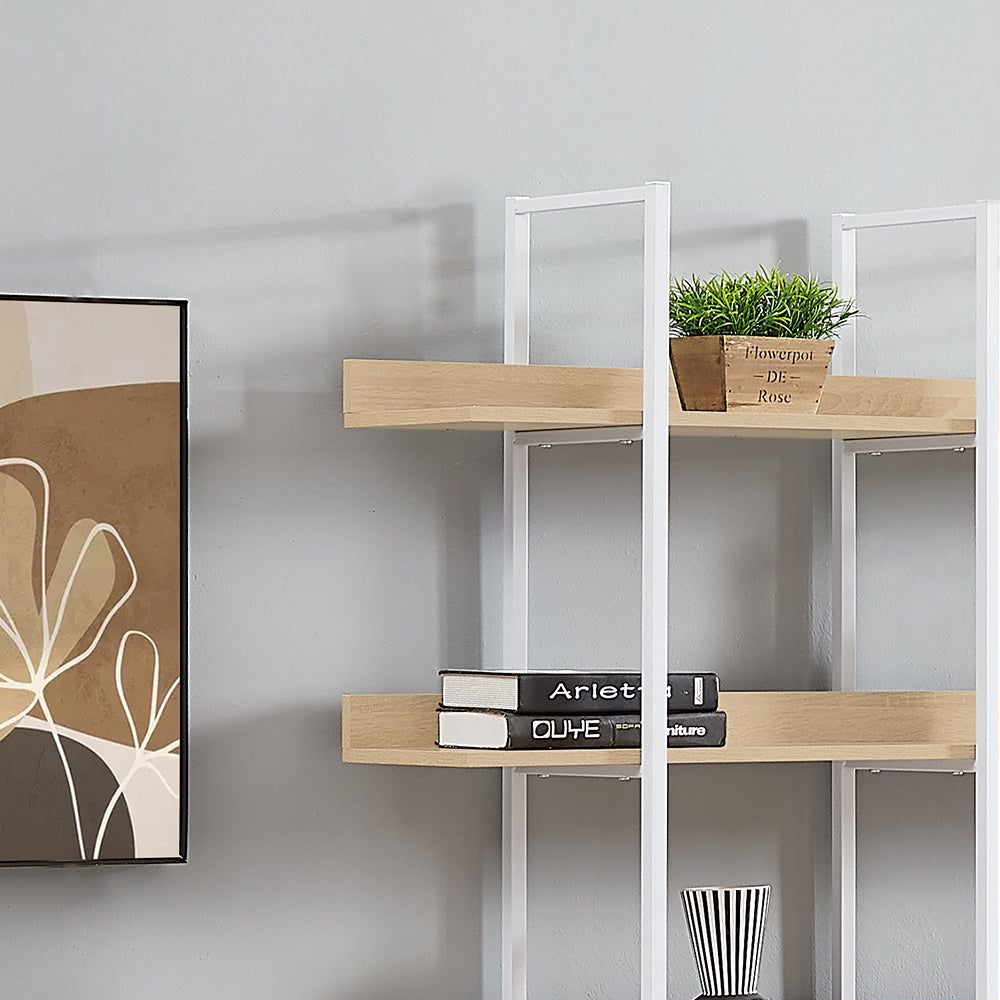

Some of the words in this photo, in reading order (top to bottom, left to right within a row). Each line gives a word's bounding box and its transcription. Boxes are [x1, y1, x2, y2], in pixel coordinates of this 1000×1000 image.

[745, 346, 814, 364] Flowerpot
[767, 370, 787, 383] DE
[758, 390, 792, 403] Rose
[666, 723, 707, 738] niture
